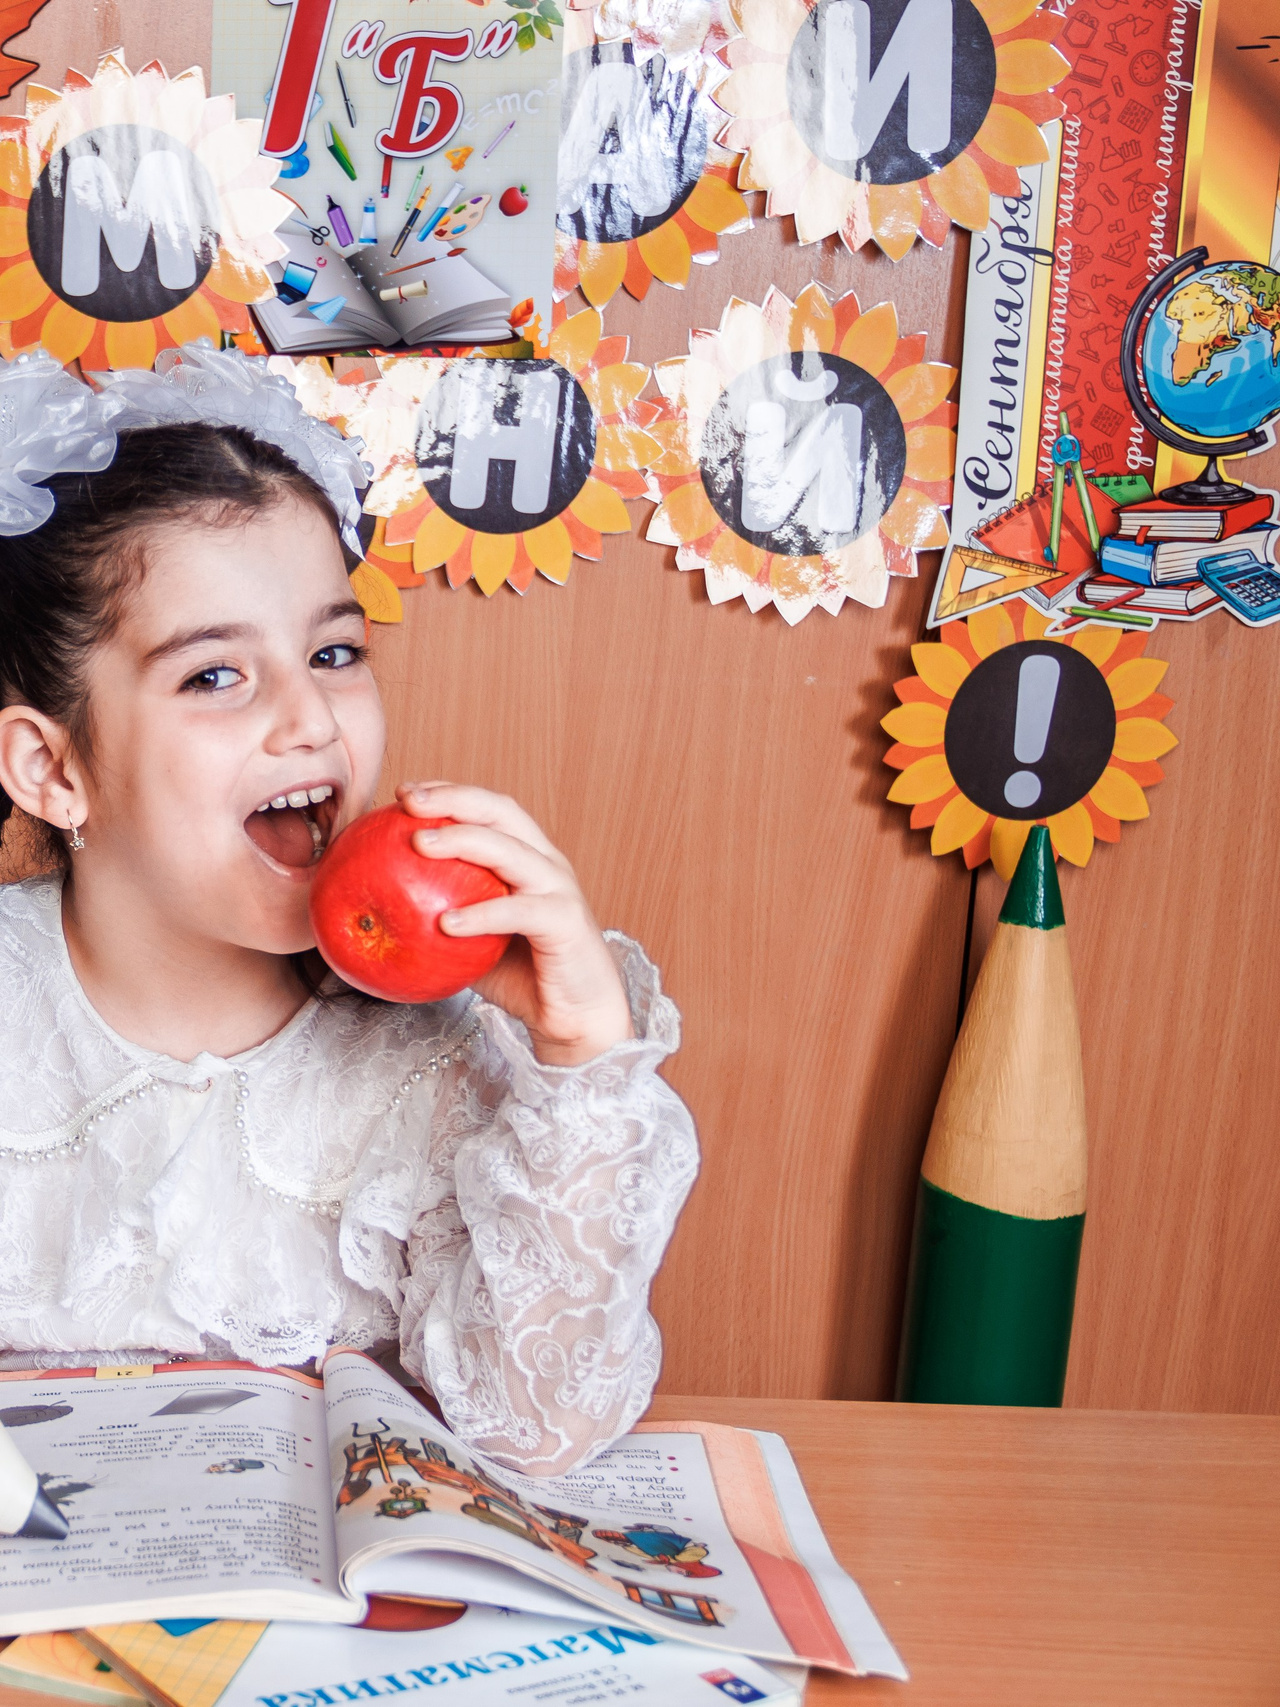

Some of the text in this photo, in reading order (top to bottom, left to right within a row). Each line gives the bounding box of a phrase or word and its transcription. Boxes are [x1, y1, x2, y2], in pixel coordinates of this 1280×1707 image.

[60, 150, 198, 297] М
[1038, 113, 1081, 478] математика химия
[963, 178, 1054, 511] Сентября
[449, 364, 562, 515] Н
[739, 367, 863, 534] Й
[1004, 654, 1061, 809] !
[96, 1422, 140, 1431] лист
[615, 1475, 666, 1485] Дверь
[256, 1624, 663, 1707] Математика
